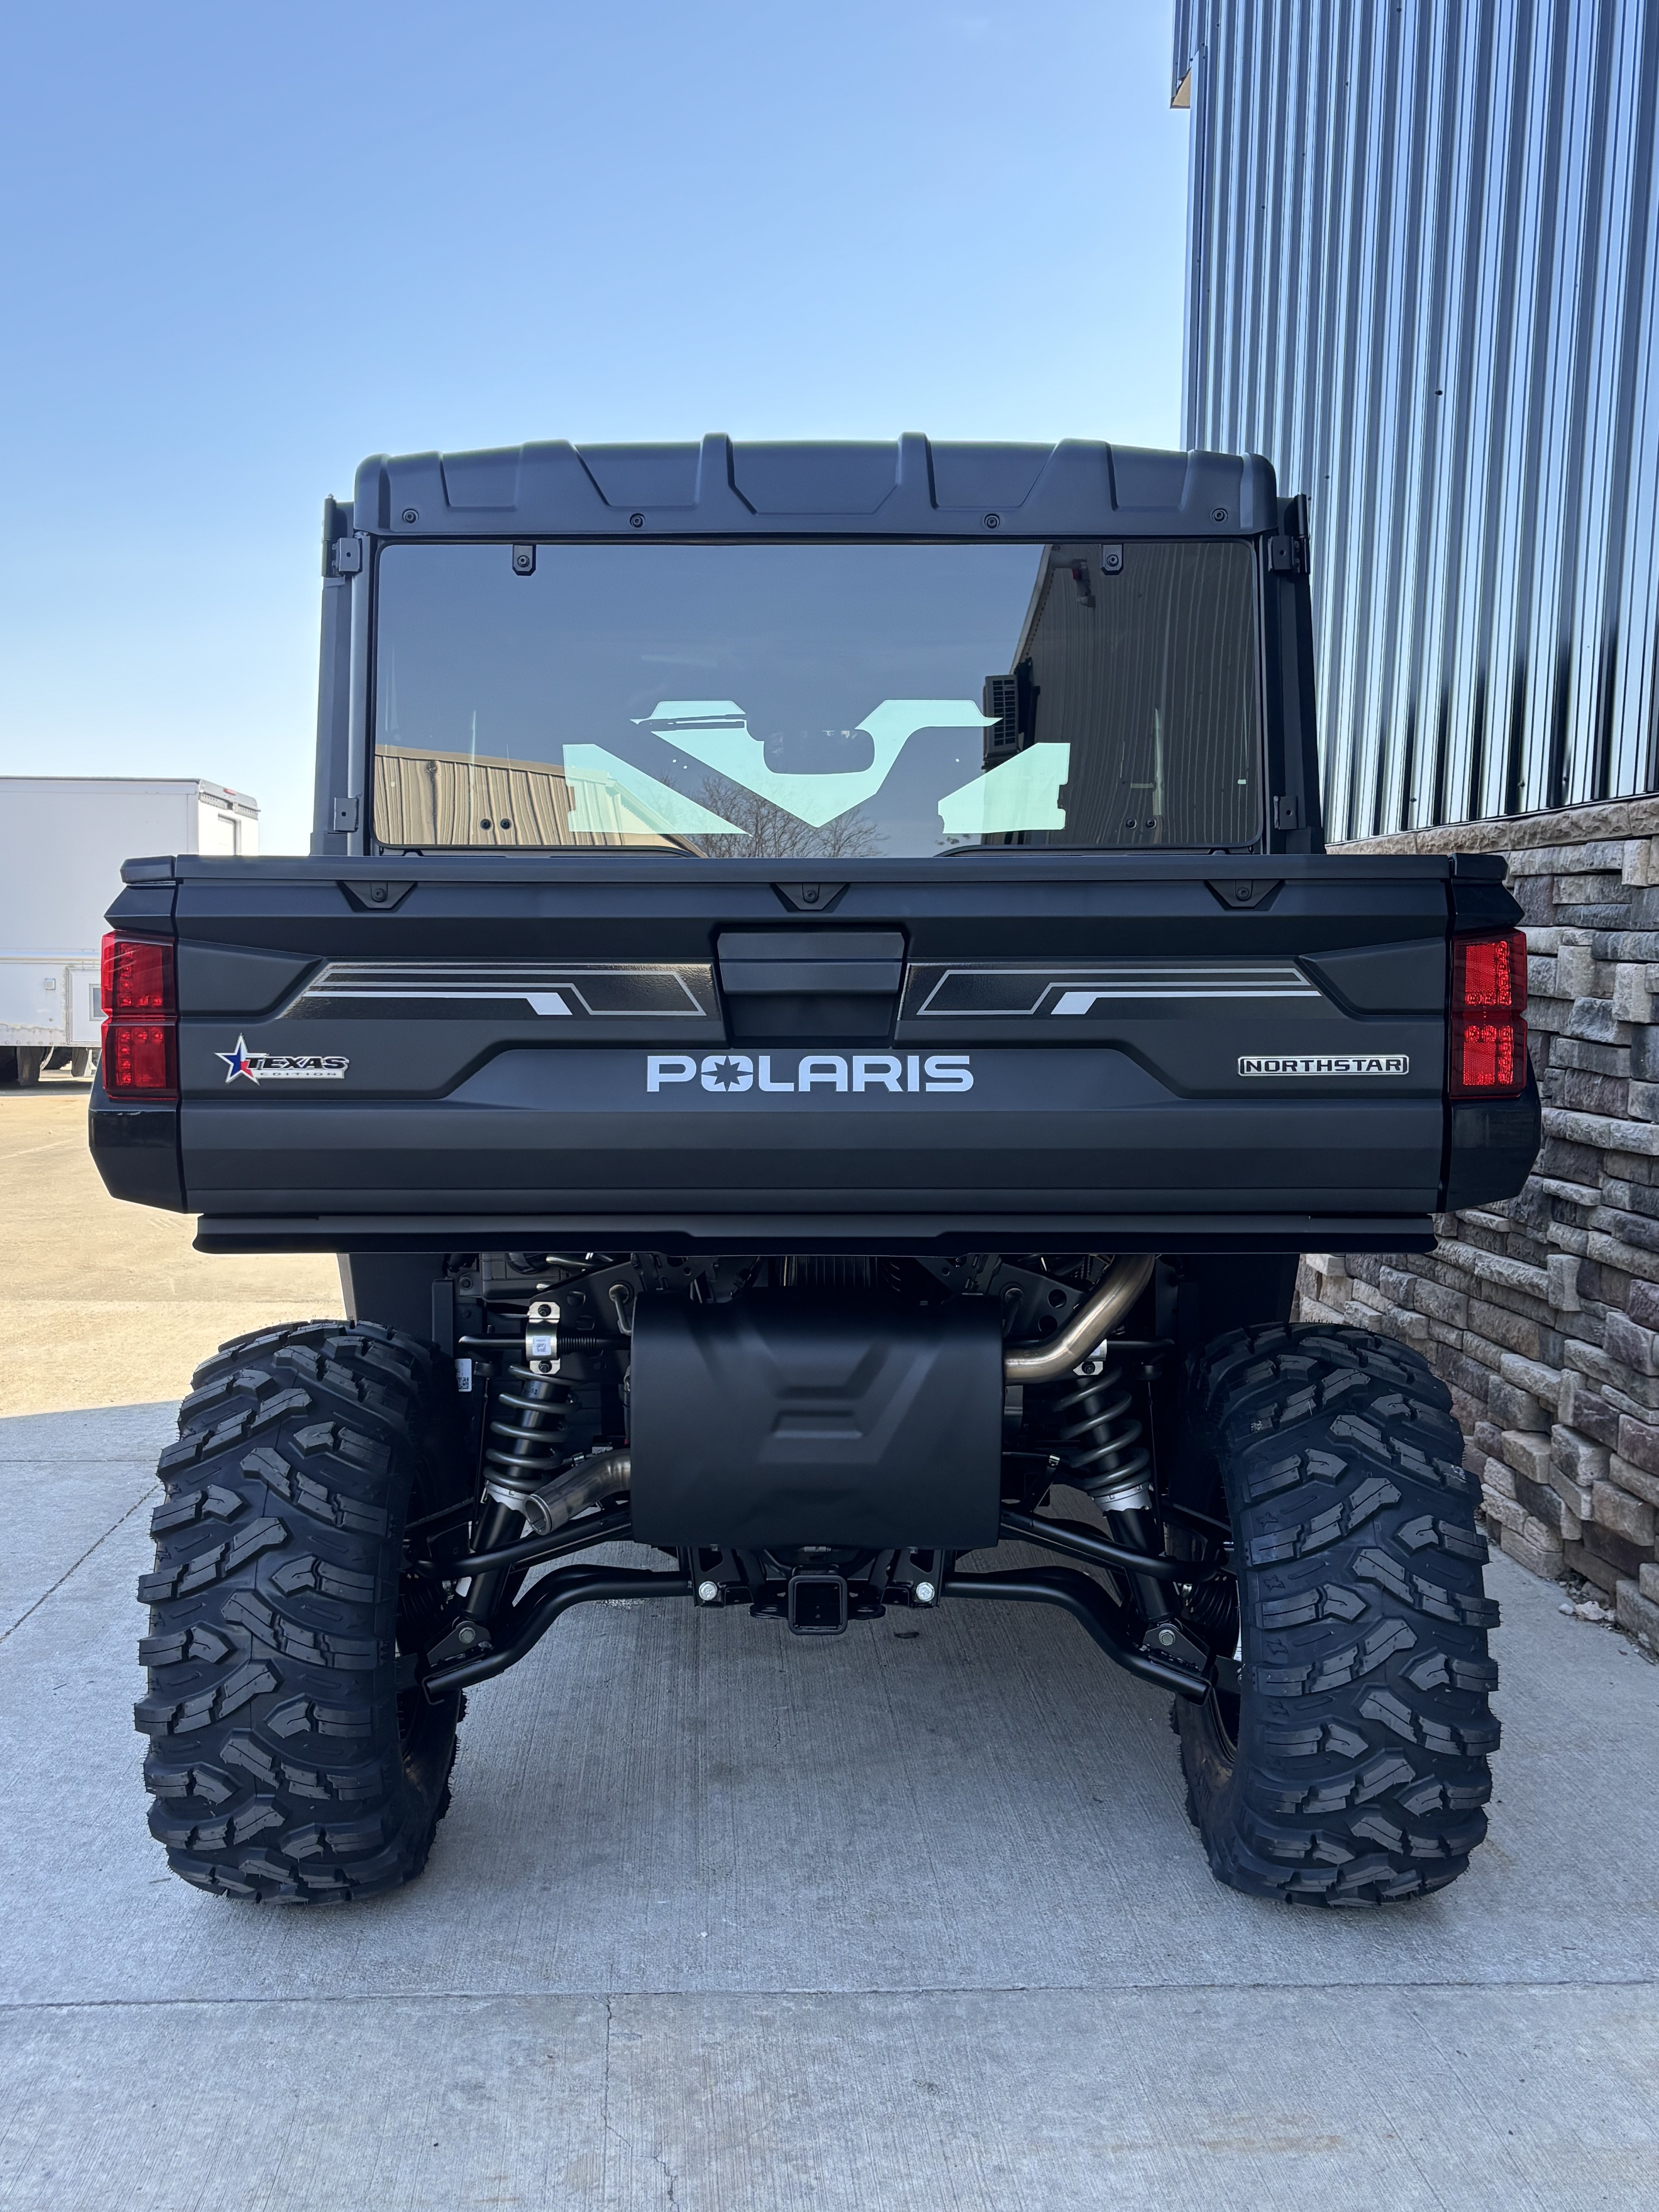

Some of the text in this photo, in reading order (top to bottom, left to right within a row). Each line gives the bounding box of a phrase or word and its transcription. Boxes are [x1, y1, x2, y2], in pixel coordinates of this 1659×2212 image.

[245, 1057, 349, 1069] TEXAS
[1246, 1059, 1401, 1072] NORTHSTAR
[647, 1055, 974, 1092] POLARIS
